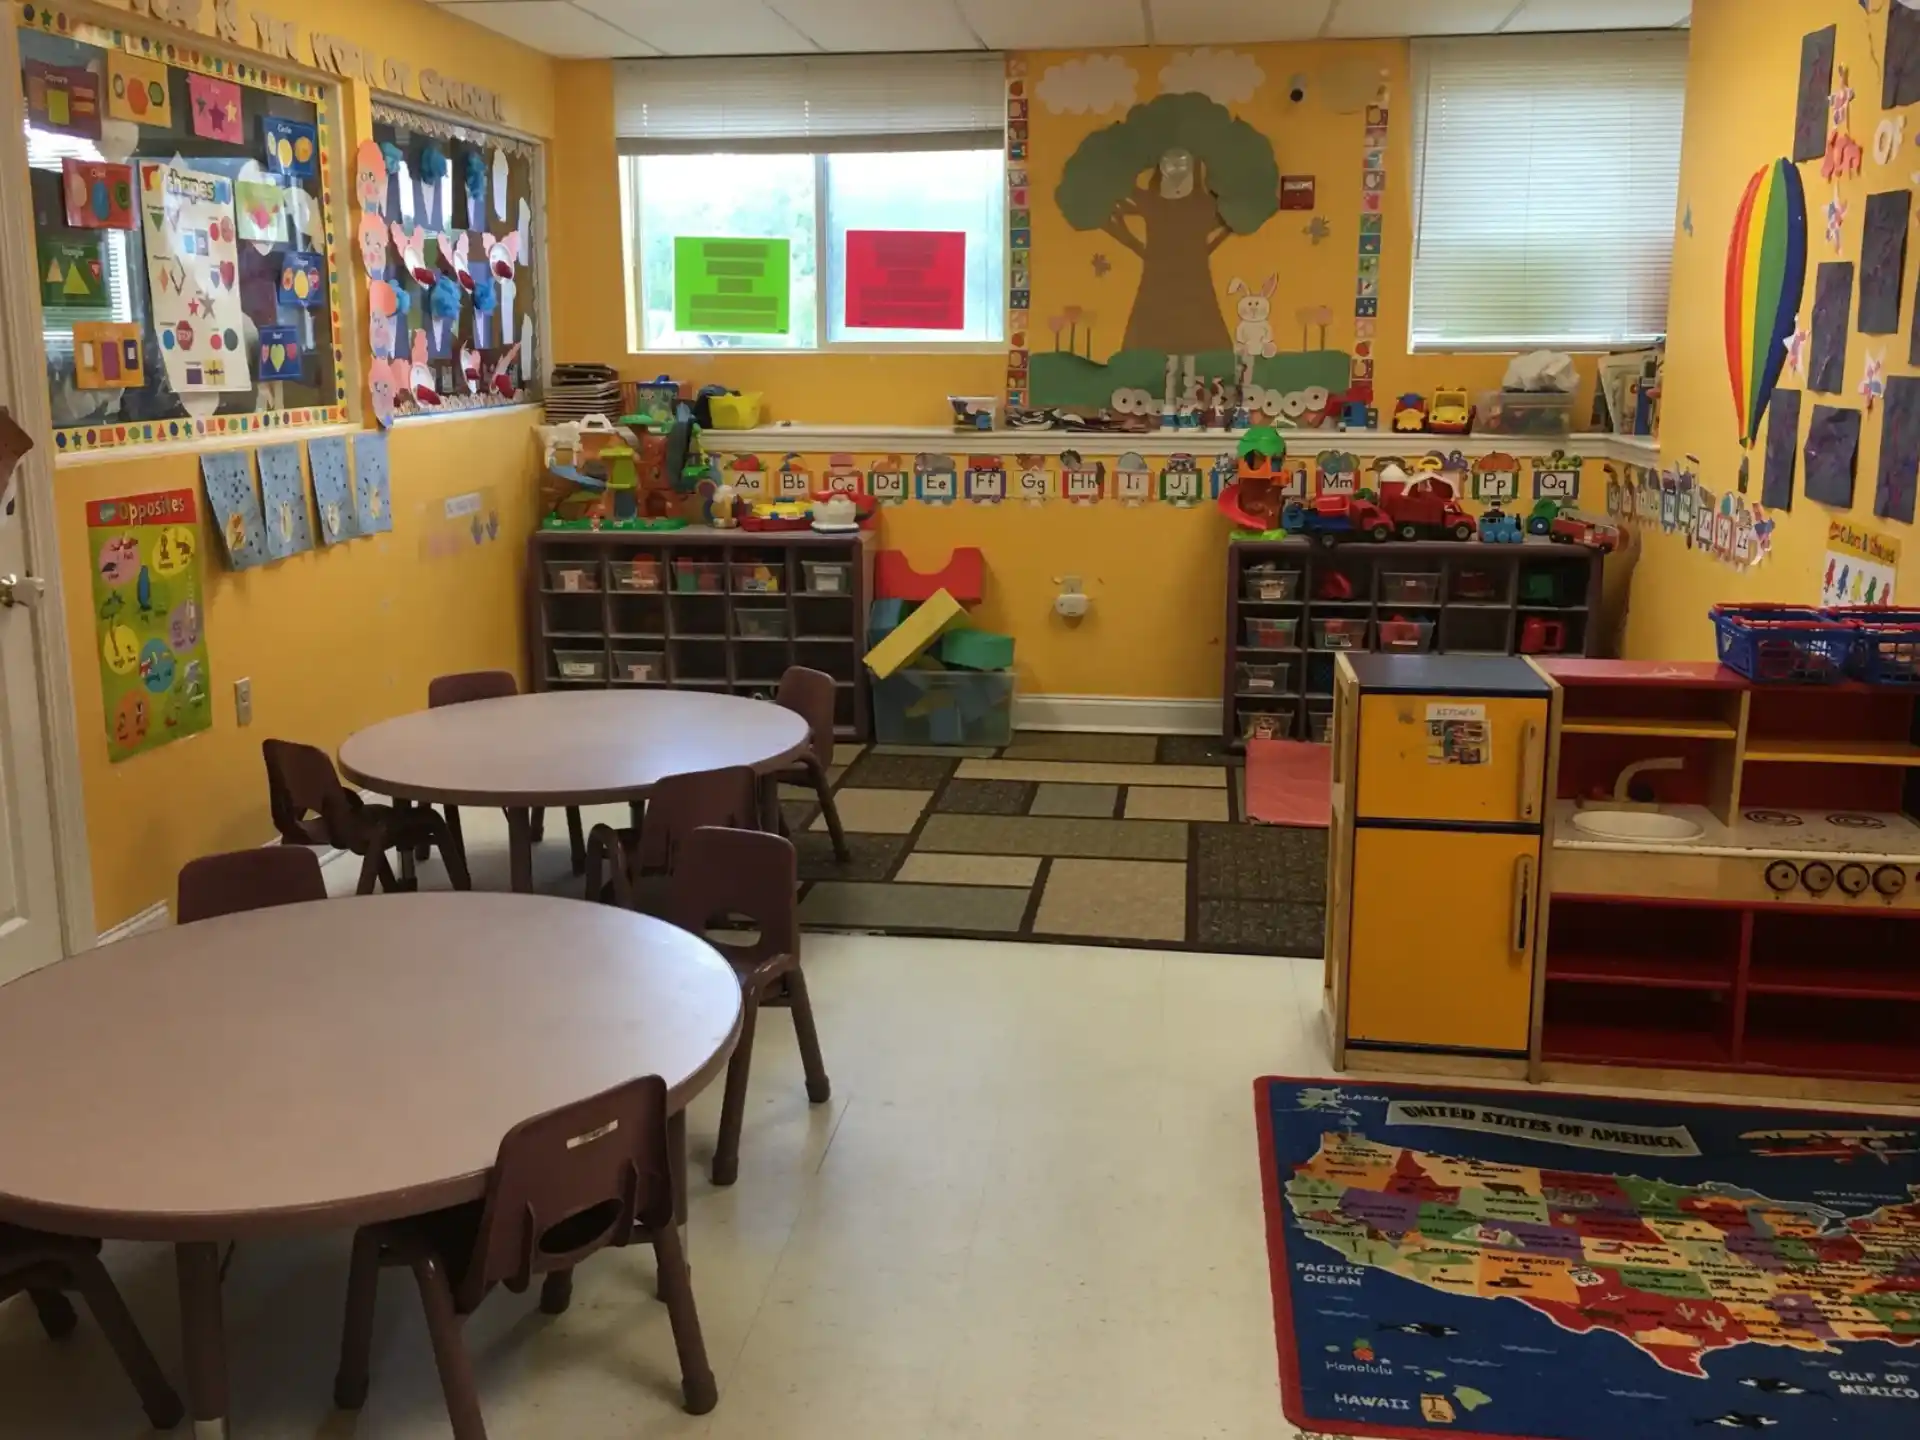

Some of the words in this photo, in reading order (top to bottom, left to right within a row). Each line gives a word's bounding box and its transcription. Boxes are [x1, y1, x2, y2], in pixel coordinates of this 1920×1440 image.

[735, 473, 760, 489] Aa
[783, 473, 806, 489] Bb
[831, 476, 855, 492] Cc
[876, 474, 900, 490] Dd
[926, 474, 946, 490] Ee
[975, 472, 996, 488] Ff
[1021, 472, 1045, 494] Gg
[1071, 472, 1098, 489] Hh
[1127, 473, 1140, 489] Ii
[1170, 472, 1190, 494] Jj
[1322, 474, 1353, 489] Mm
[1483, 473, 1506, 493] Pp
[1541, 473, 1568, 497] Qq
[119, 496, 185, 526] Opposites
[1399, 1104, 1476, 1121] UNITED
[1482, 1111, 1551, 1133] STATES
[1557, 1123, 1583, 1138] OF
[1591, 1127, 1684, 1150] AMERICA
[1295, 1262, 1365, 1276] PACIFIC
[1303, 1273, 1363, 1288] OCEAN
[1325, 1360, 1393, 1376] Honolulu
[1828, 1369, 1877, 1383] GULF
[1884, 1373, 1910, 1385] OF
[1837, 1384, 1919, 1399] MEXICO
[1333, 1393, 1411, 1410] HAWAII
